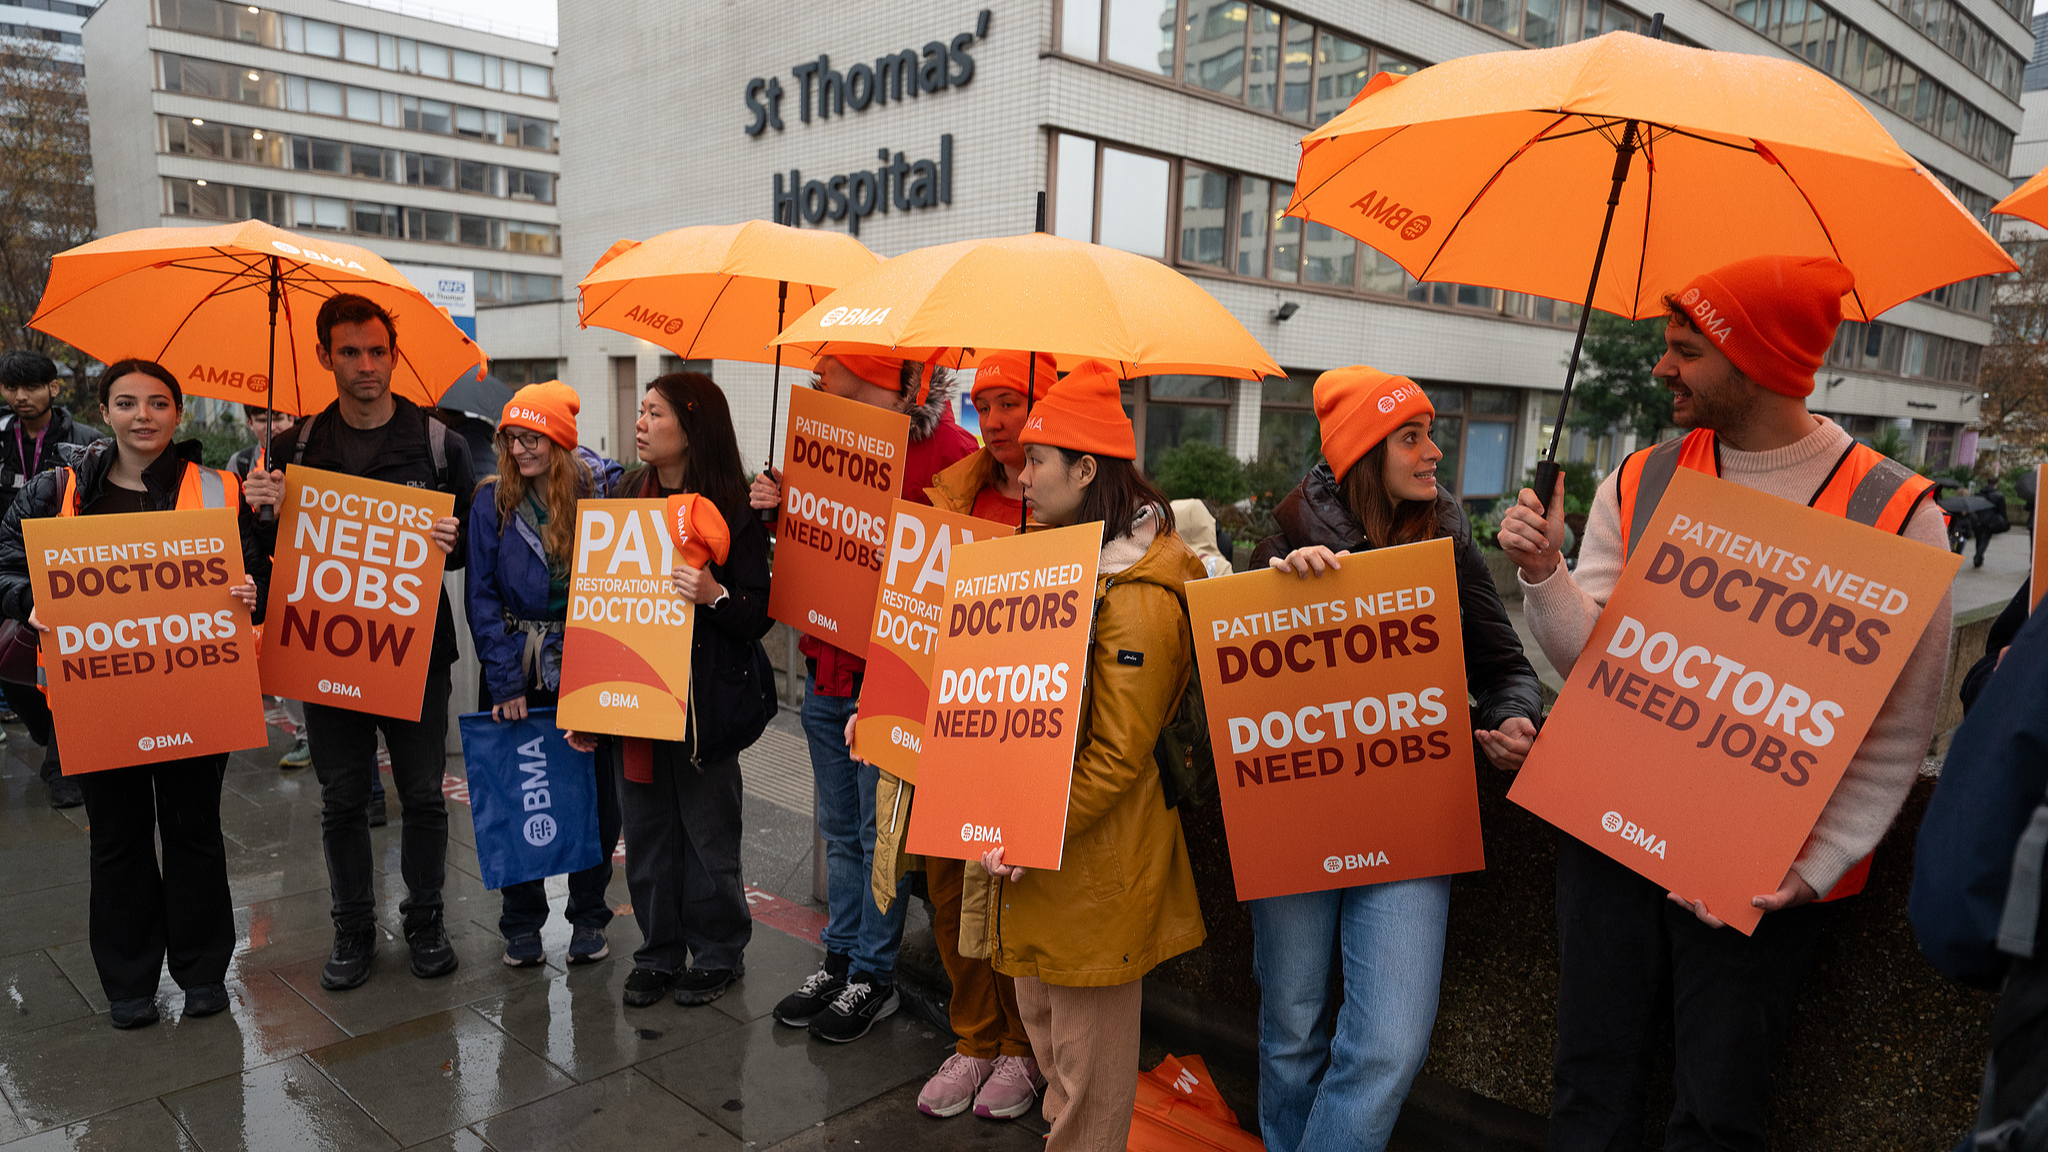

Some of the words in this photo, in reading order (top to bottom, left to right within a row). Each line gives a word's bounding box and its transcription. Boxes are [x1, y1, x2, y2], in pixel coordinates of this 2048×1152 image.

[744, 78, 784, 136] St
[773, 133, 954, 235] Hospital
[302, 248, 367, 273] BMA
[845, 306, 890, 327] BMA
[1693, 299, 1733, 344] BMA
[1391, 383, 1422, 403] BMA
[521, 408, 546, 426] BMA
[795, 416, 855, 447] PATIENTS
[857, 435, 895, 459] NEED
[1025, 416, 1043, 431] MA
[792, 436, 891, 492] DOCTORS
[300, 486, 433, 528] DOCTORS
[786, 487, 886, 546] DOCTORS
[44, 544, 157, 567] PATIENTS
[163, 538, 225, 555] NEED
[294, 511, 428, 569] NEED
[577, 510, 674, 576] PAY
[678, 517, 688, 545] BMA
[784, 517, 830, 557] NEED
[834, 535, 881, 572] JOBS
[886, 512, 998, 594] PA
[1668, 514, 1811, 581] PATIENTS
[1811, 564, 1908, 616] NEED
[48, 558, 229, 599] DOCTORS
[287, 560, 420, 615] JOBS
[575, 577, 658, 594] RESTORATION
[662, 581, 679, 594] FO
[954, 570, 1029, 598] PATIENTS
[1033, 564, 1083, 588] NEED
[572, 595, 686, 626] DOCTORS
[818, 614, 838, 633] BMA
[882, 589, 943, 623] RESTORATI
[949, 590, 1078, 638] DOCTORS
[1212, 601, 1347, 641] PATIENTS
[1355, 587, 1436, 618] NEED
[1645, 542, 1891, 665] DOCTORS
[56, 610, 236, 655] DOCTORS
[280, 604, 415, 666] NOW
[876, 609, 939, 655] DOCT
[1216, 615, 1440, 685] DOCTORS
[62, 650, 156, 682] NEED
[164, 641, 240, 673] JOBS
[1605, 615, 1845, 747] DOCTORS
[332, 683, 362, 698] BMA
[612, 693, 639, 709] BMA
[939, 662, 1069, 705] DOCTORS
[156, 733, 193, 748] BMA
[934, 710, 996, 738] NEED
[999, 708, 1063, 743] JOBS
[1228, 687, 1448, 754] DOCTORS
[1587, 660, 1702, 731] NEED
[1697, 713, 1819, 787] JOBS
[517, 735, 550, 812] BMA
[1234, 747, 1344, 788] NEED
[1354, 730, 1451, 777] JOBS
[973, 825, 1002, 844] BMA
[1620, 820, 1668, 860] BMA
[1345, 851, 1390, 871] BMA
